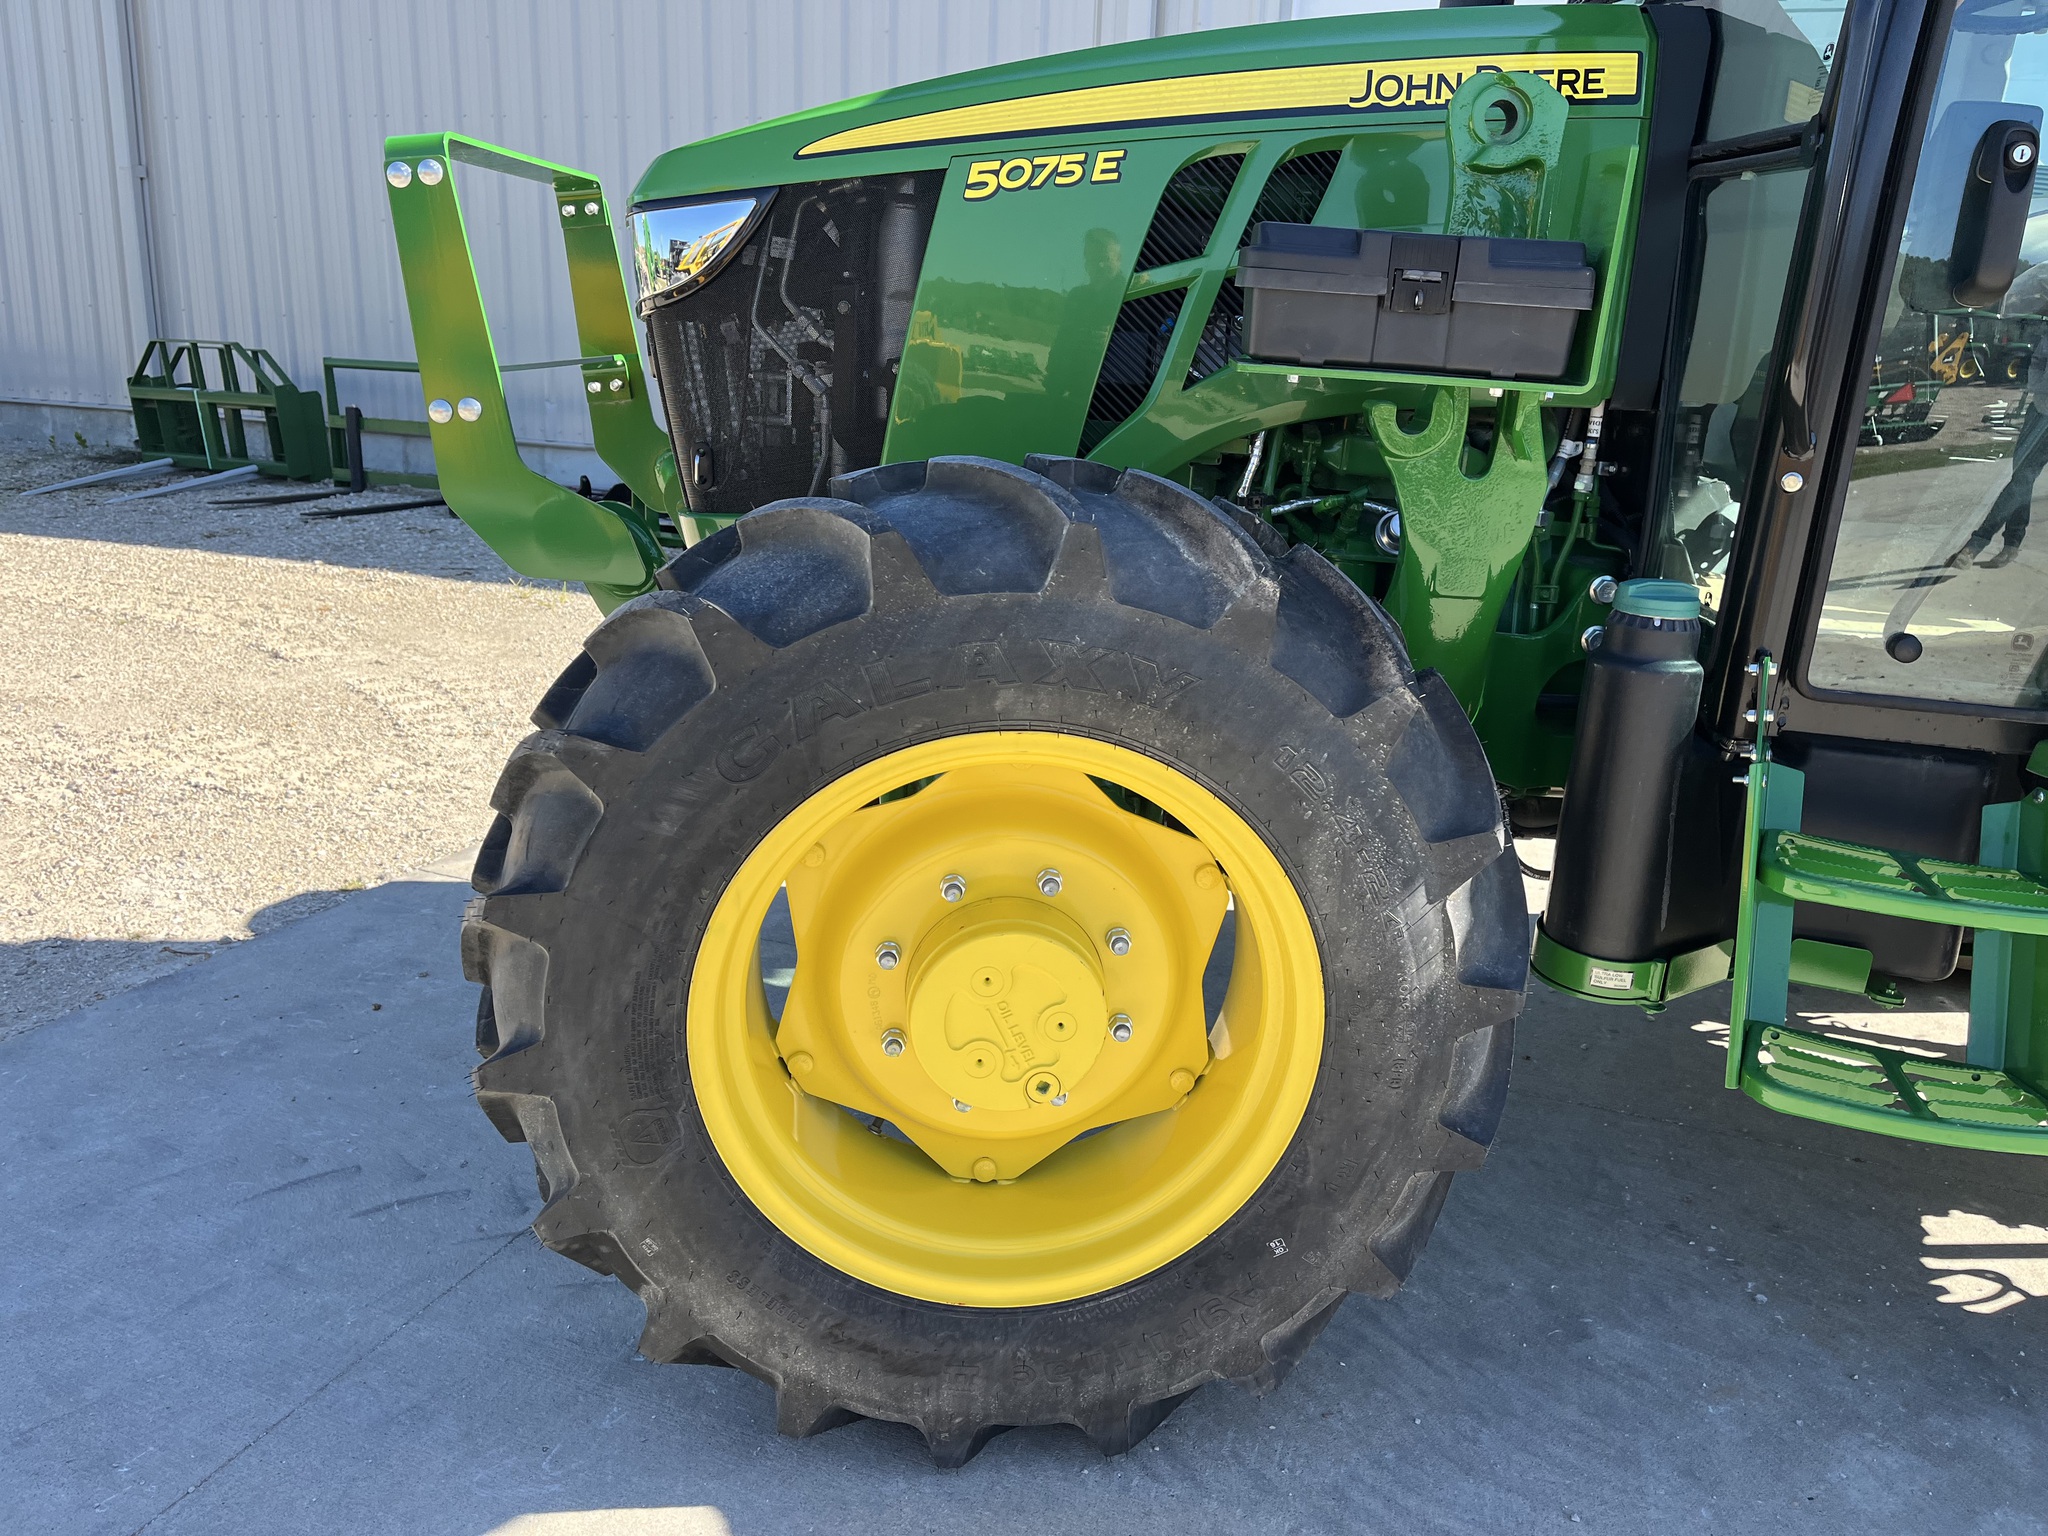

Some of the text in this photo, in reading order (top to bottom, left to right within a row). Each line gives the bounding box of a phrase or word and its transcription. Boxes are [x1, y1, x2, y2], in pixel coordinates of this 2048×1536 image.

[1349, 69, 1462, 103] JOHN
[963, 149, 1128, 202] 5075 E
[716, 638, 1202, 783] GALAXY
[1274, 745, 1413, 942] 12.4-24
[1594, 970, 1612, 978] ULTRA
[997, 1001, 1035, 1066] OIL LEVEL
[726, 1269, 810, 1330] TUBELESS
